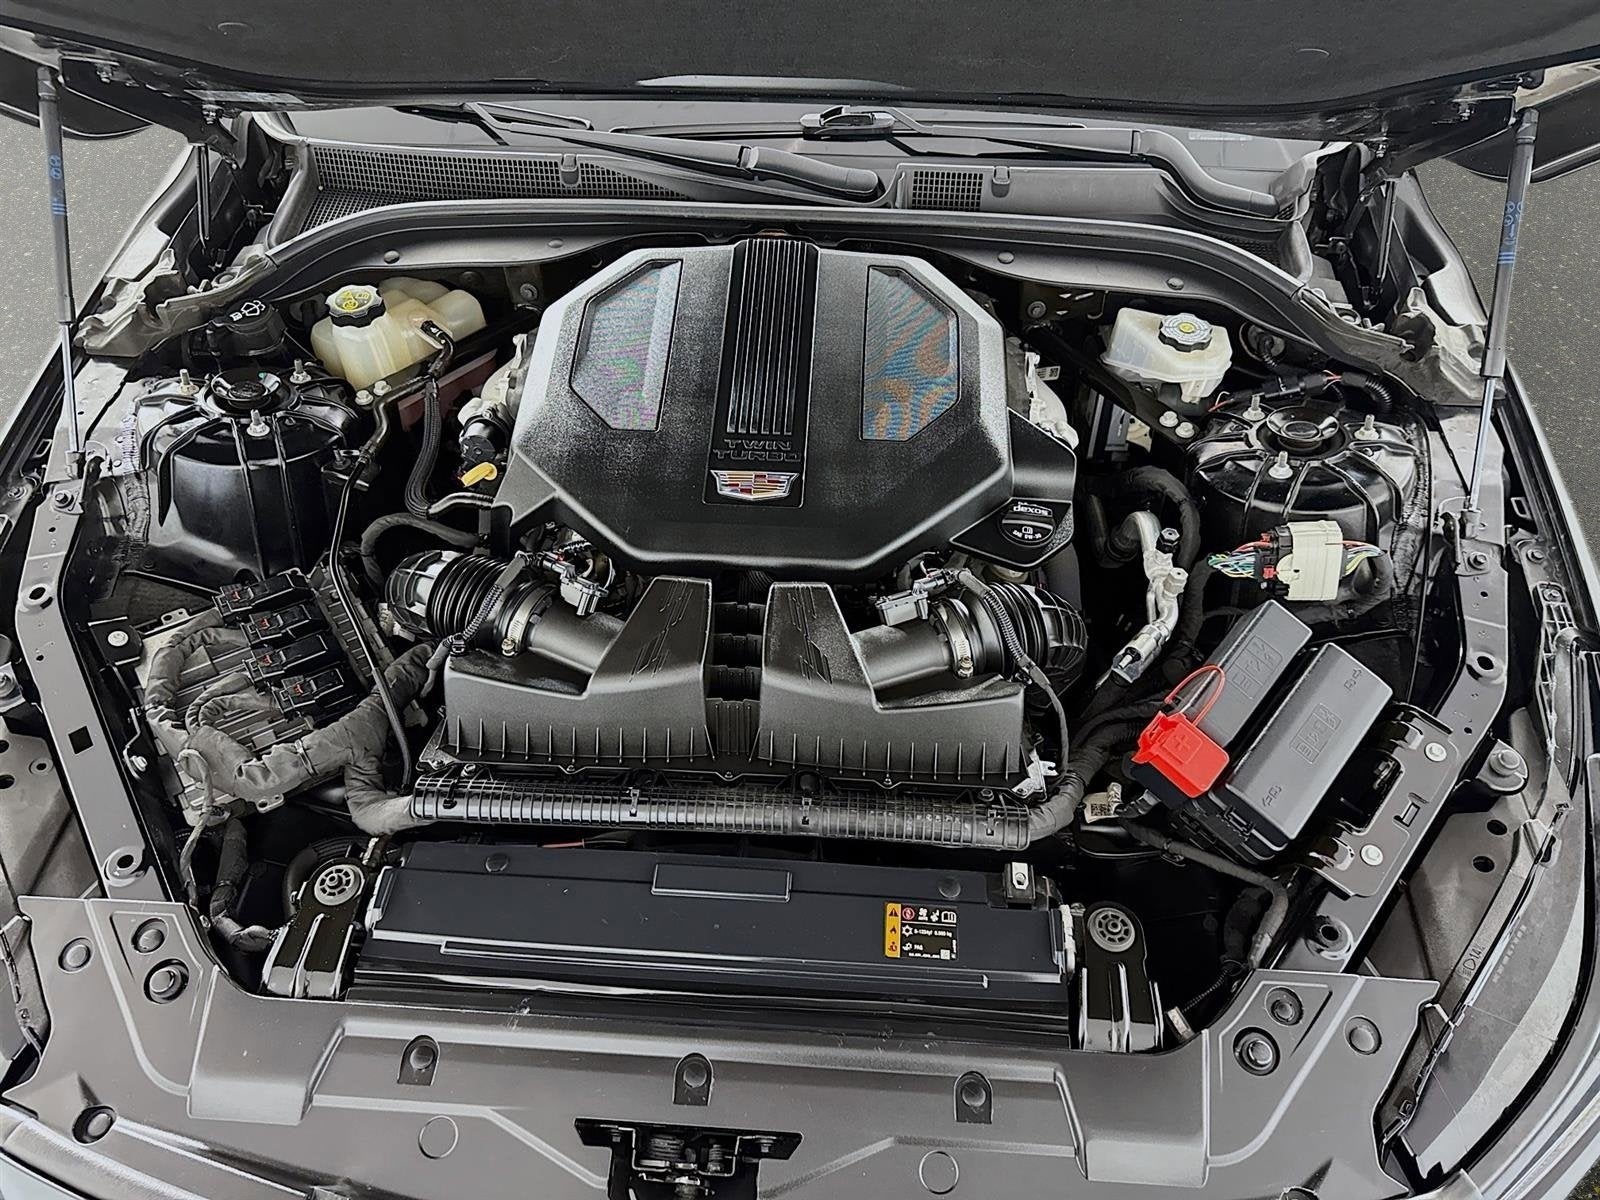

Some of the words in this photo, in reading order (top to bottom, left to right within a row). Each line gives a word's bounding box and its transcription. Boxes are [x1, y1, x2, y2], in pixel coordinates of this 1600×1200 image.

[724, 439, 791, 451] TWIN
[713, 449, 801, 461] TURBO
[1013, 504, 1048, 516] dexos
